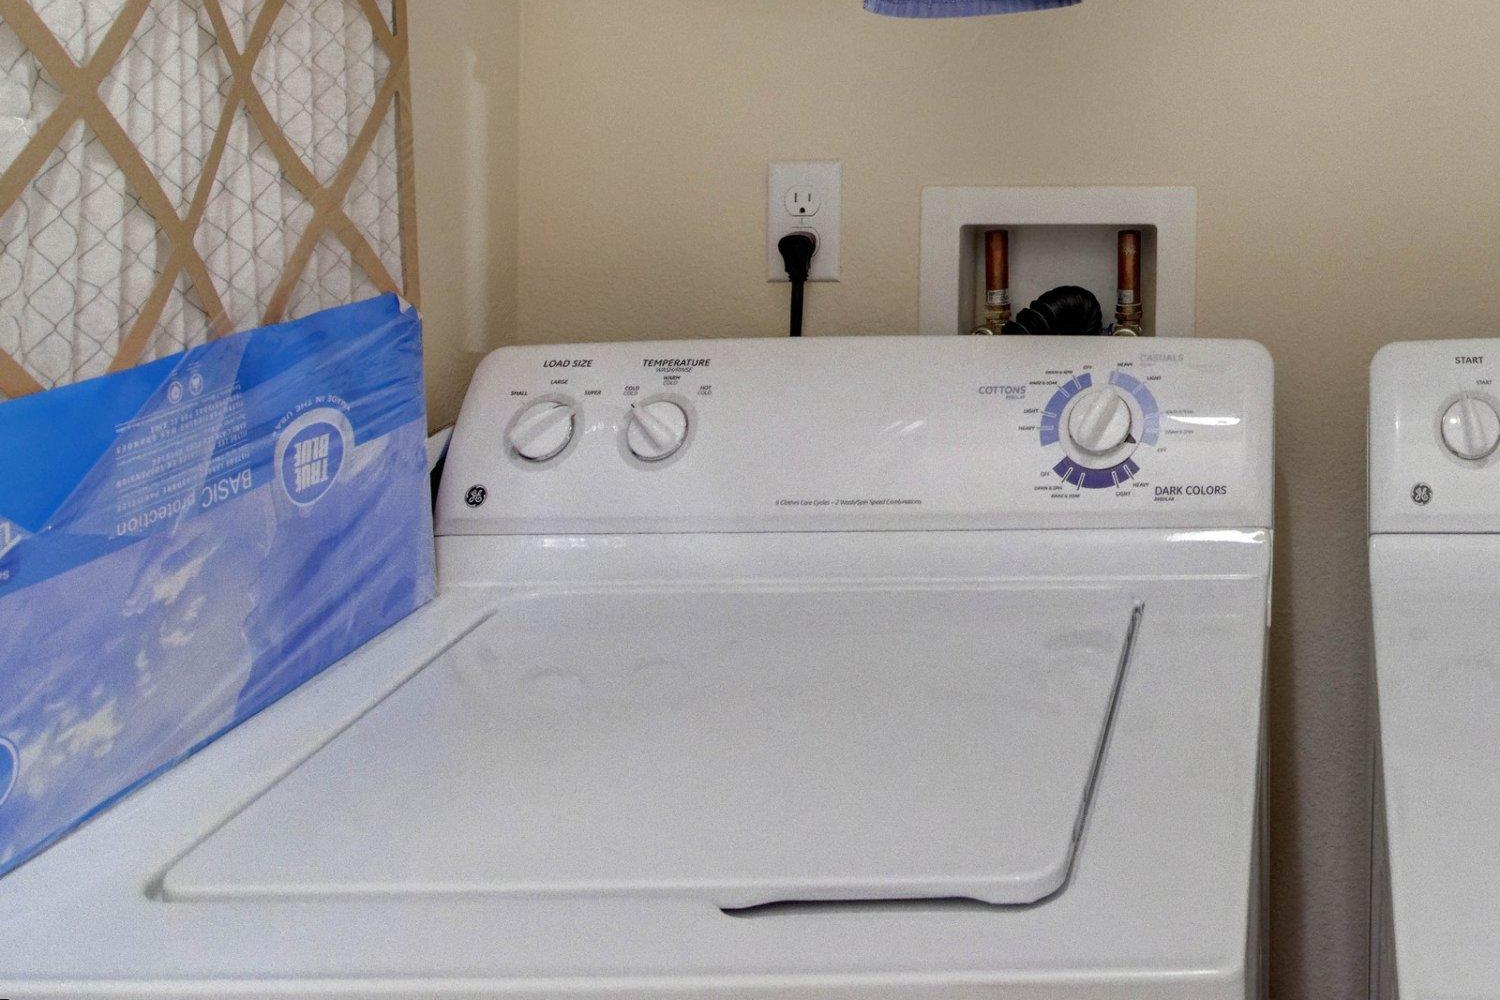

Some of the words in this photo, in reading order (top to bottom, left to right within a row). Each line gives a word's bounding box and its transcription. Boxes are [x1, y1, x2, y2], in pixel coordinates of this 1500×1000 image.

[543, 360, 571, 368] LOAD
[572, 360, 594, 368] SIZE
[643, 359, 711, 367] TEMPERATURE
[1455, 356, 1483, 365] START
[978, 385, 1027, 395] COTTONS
[293, 433, 331, 468] BLUE
[295, 456, 328, 493] TRUE
[202, 469, 252, 509] BASIC
[1154, 486, 1183, 496] DARK
[1185, 485, 1227, 496] COLORS
[117, 490, 197, 538] protection
